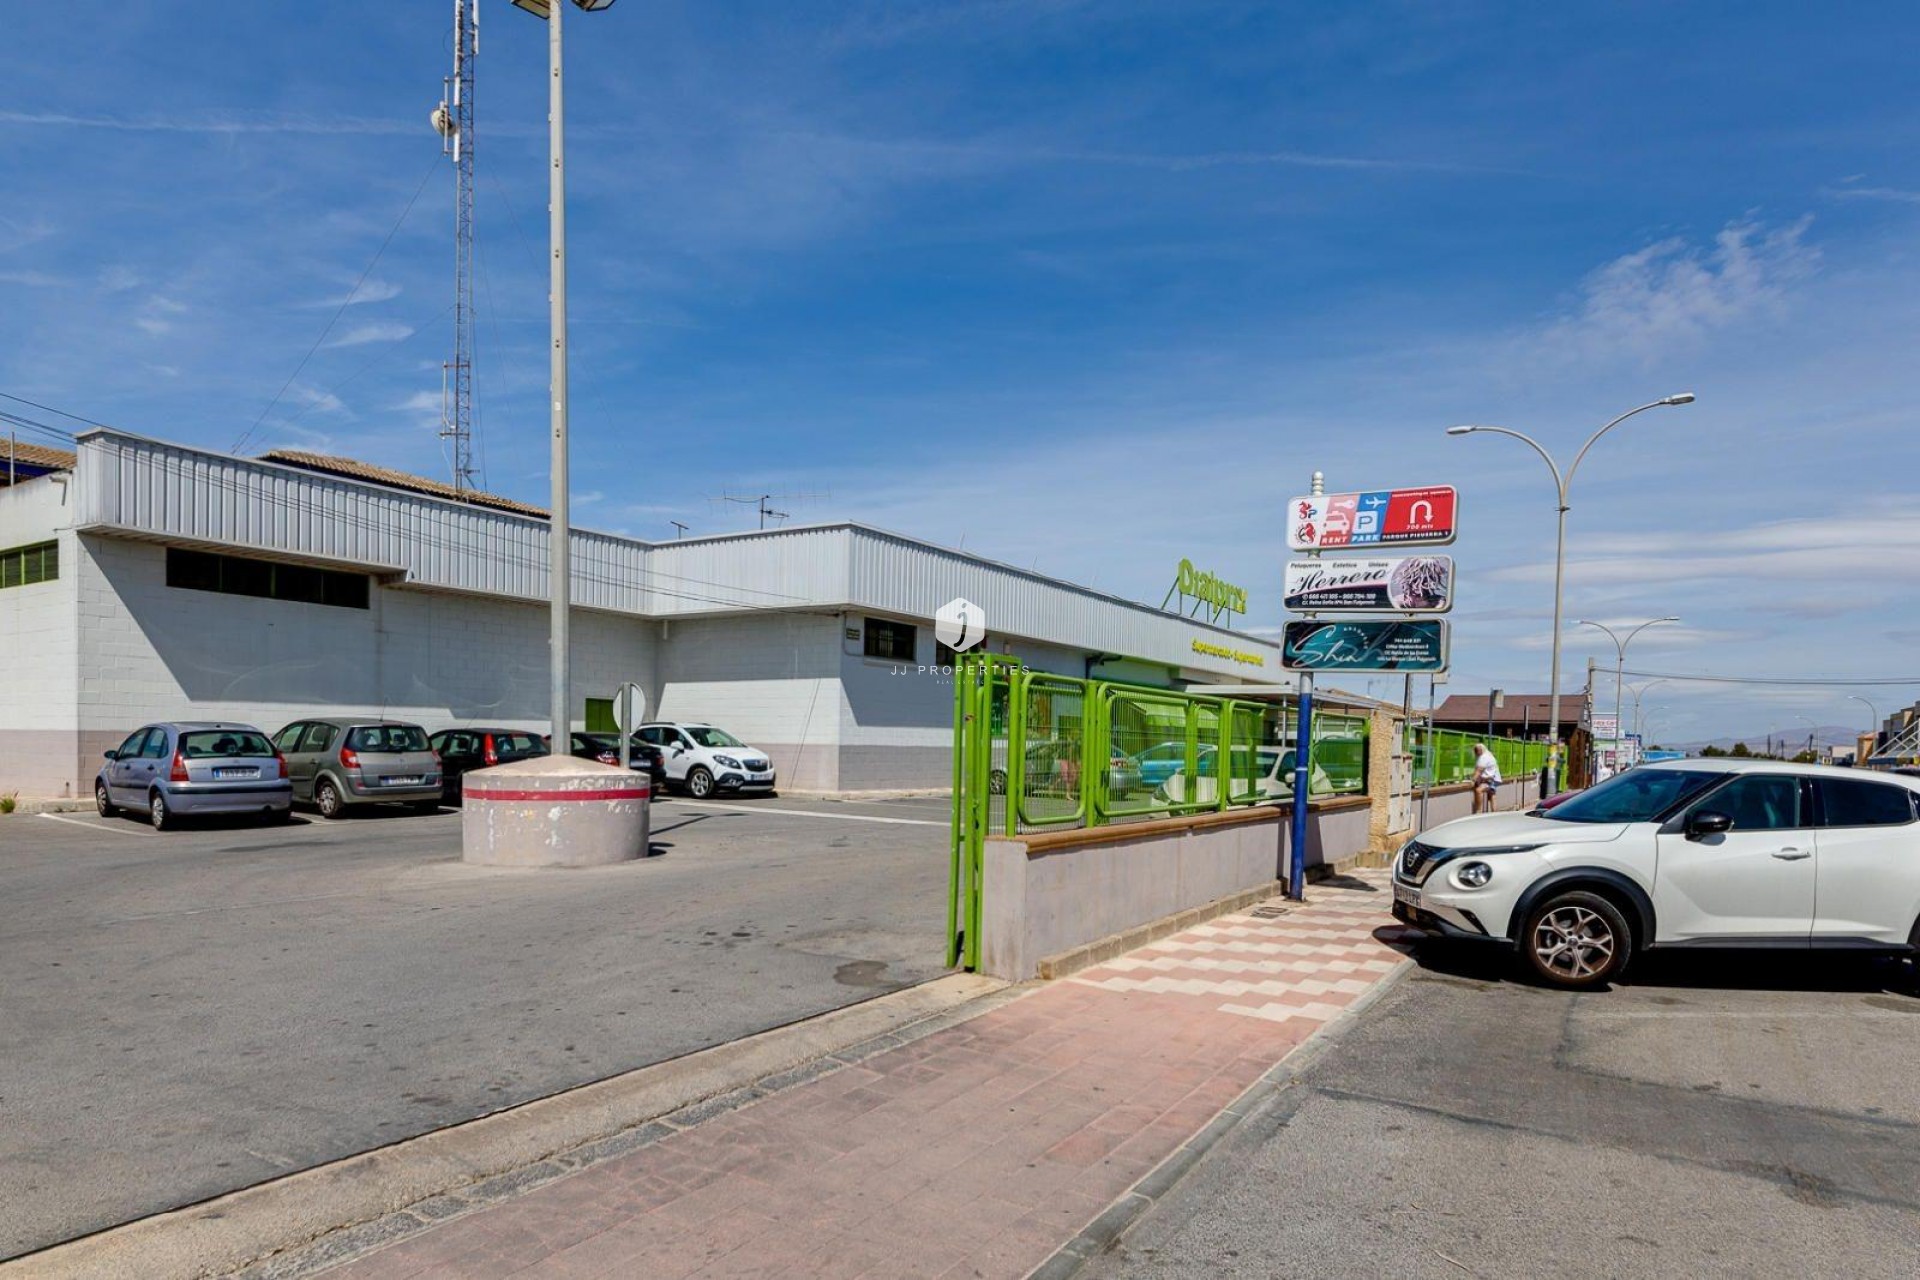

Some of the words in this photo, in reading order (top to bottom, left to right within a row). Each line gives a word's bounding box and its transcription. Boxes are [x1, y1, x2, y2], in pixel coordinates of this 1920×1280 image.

[1321, 536, 1347, 545] RENT
[1351, 534, 1379, 544] PARK
[1290, 569, 1387, 594] Herrero
